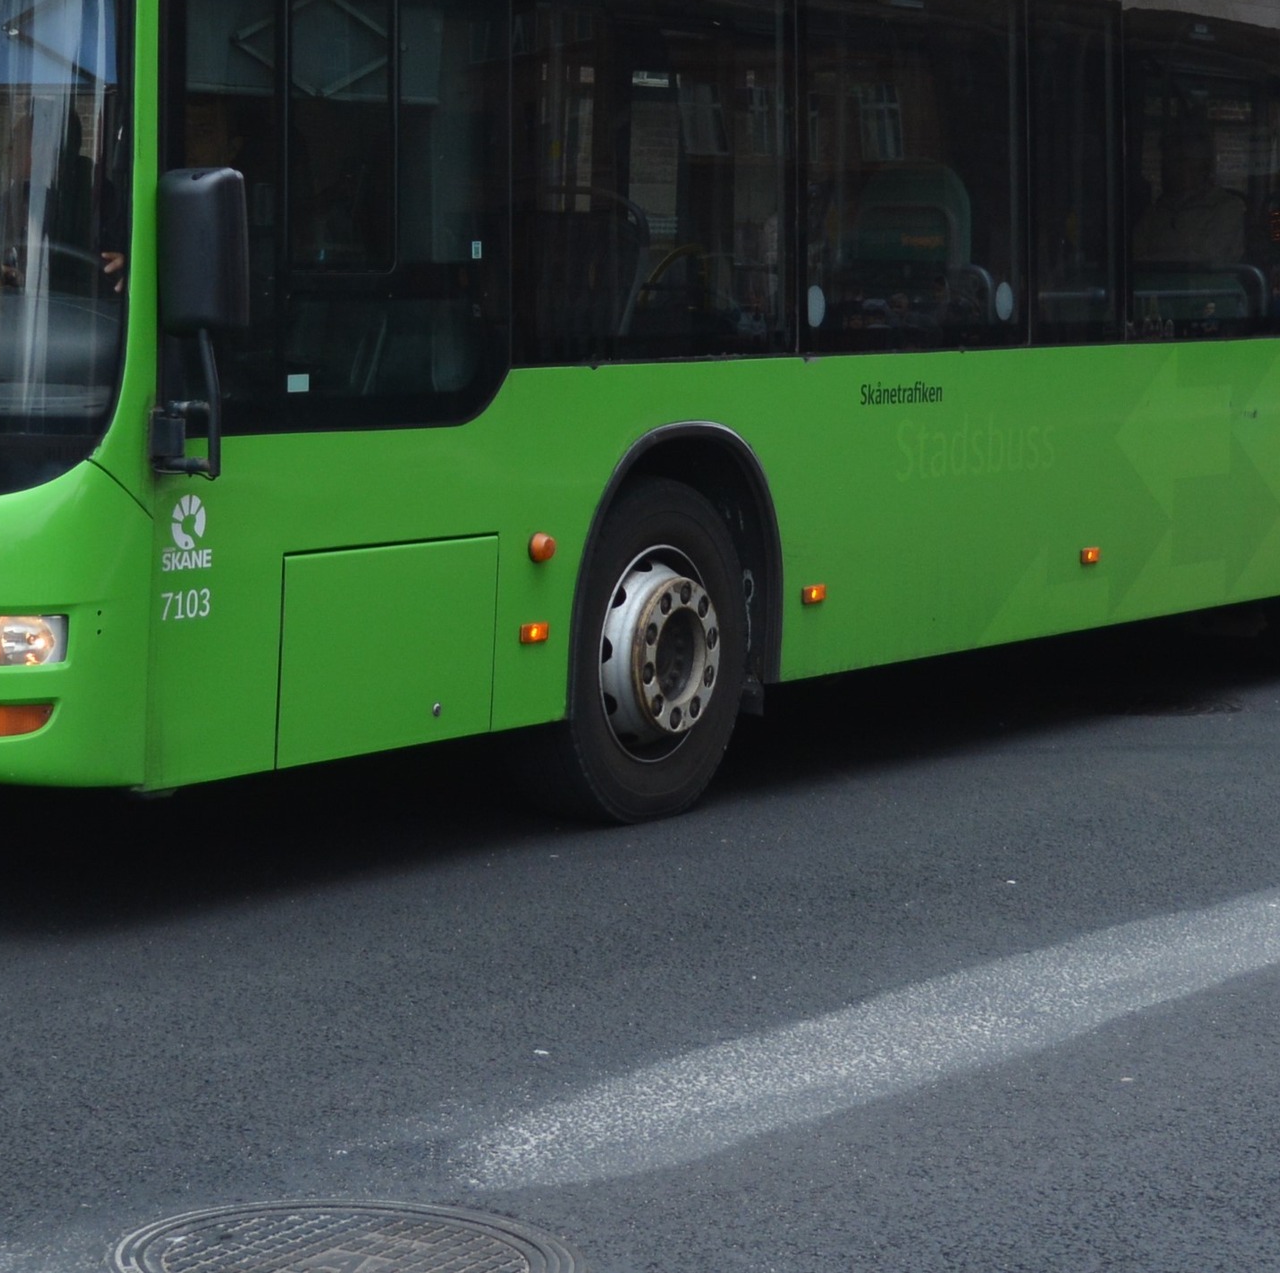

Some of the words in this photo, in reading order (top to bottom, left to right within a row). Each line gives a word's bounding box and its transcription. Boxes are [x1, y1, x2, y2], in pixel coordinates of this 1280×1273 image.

[859, 380, 943, 406] Skånetrafiken
[895, 412, 1057, 484] Stadsbuss
[161, 587, 211, 621] 7103
